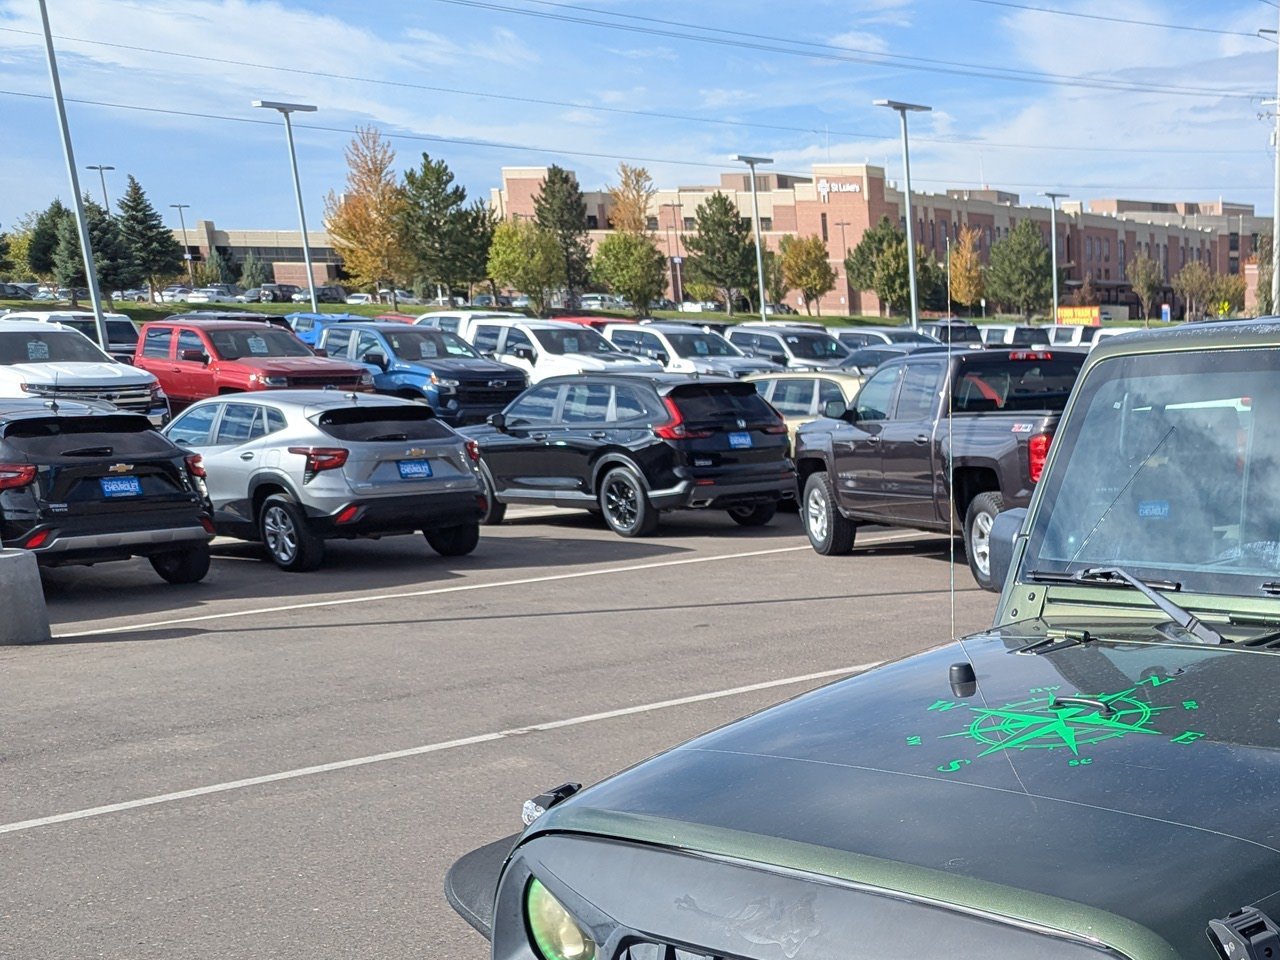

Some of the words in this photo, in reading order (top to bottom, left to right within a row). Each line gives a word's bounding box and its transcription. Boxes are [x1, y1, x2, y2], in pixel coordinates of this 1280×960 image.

[104, 483, 140, 492] CHEVROLET
[1135, 675, 1176, 687] N
[927, 700, 969, 712] W
[1169, 731, 1205, 745] E
[936, 759, 972, 772] S
